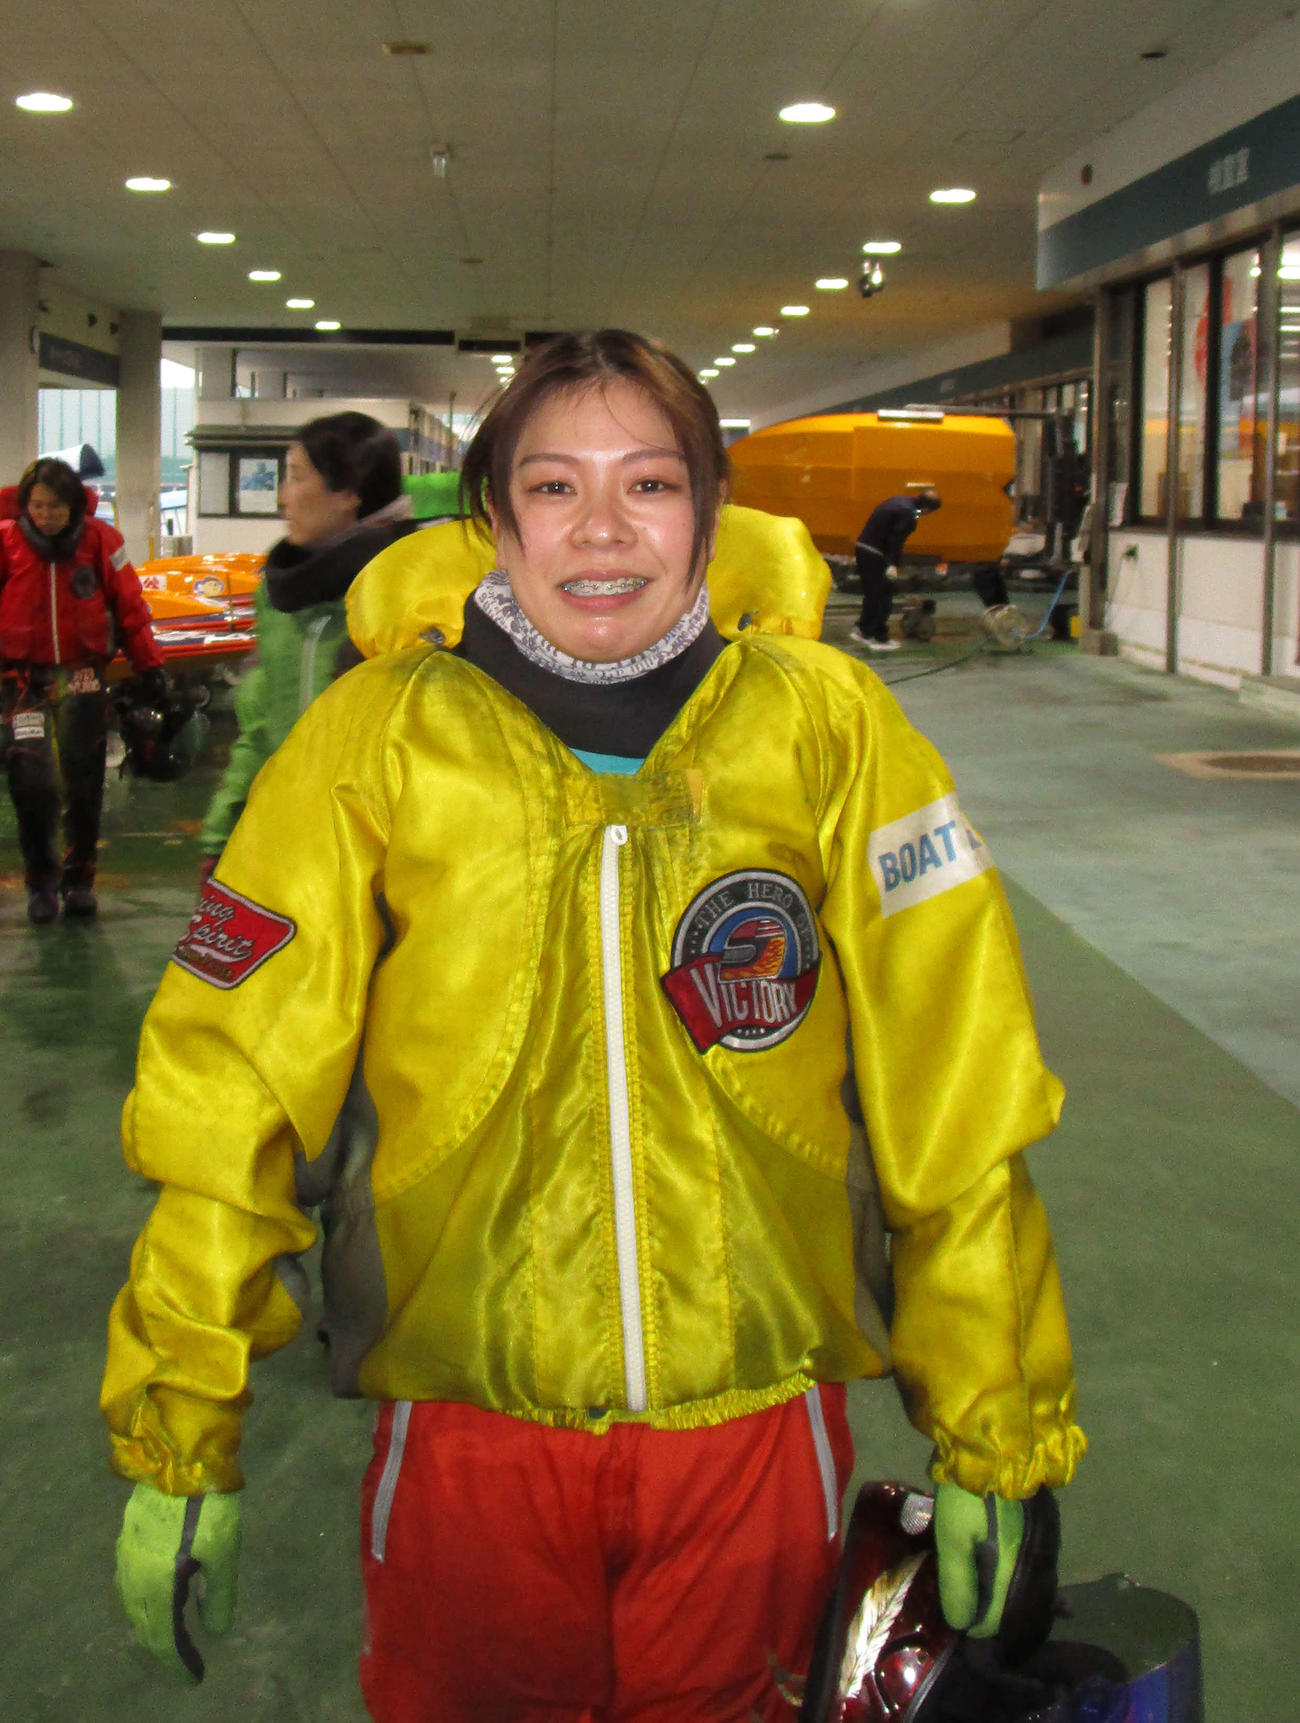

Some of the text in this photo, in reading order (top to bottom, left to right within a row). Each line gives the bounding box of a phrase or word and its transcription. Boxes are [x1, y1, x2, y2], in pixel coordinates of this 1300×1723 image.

[878, 820, 957, 892] BOAT
[697, 890, 735, 929] THE
[746, 882, 794, 909] HERO
[690, 962, 798, 1028] VICTORY
